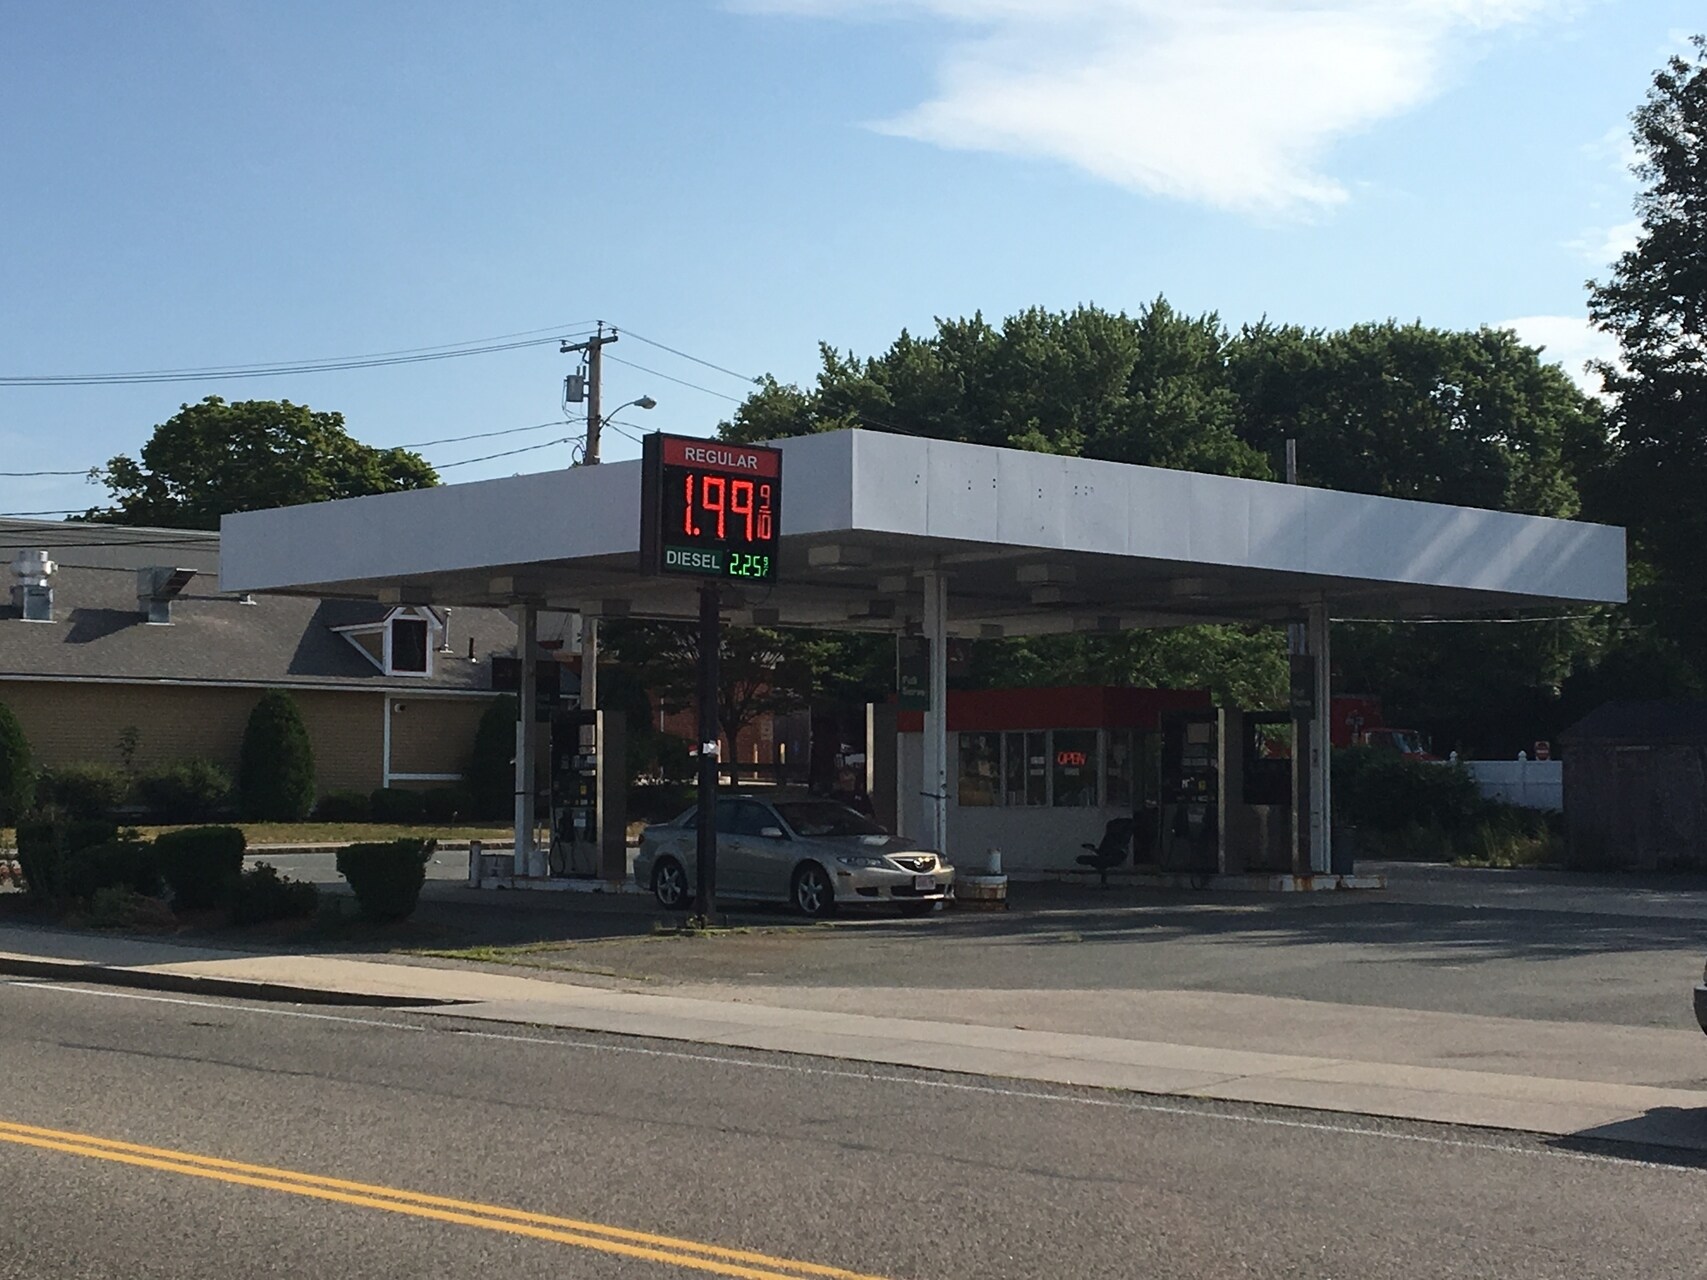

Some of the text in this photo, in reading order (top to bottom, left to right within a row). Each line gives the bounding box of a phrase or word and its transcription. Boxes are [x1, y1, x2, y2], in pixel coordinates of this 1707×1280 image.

[685, 447, 758, 470] REGULAR
[684, 474, 754, 542] 1.99
[666, 550, 721, 569] DIESEL
[730, 553, 761, 577] 2.25
[1057, 751, 1088, 766] OPEN
